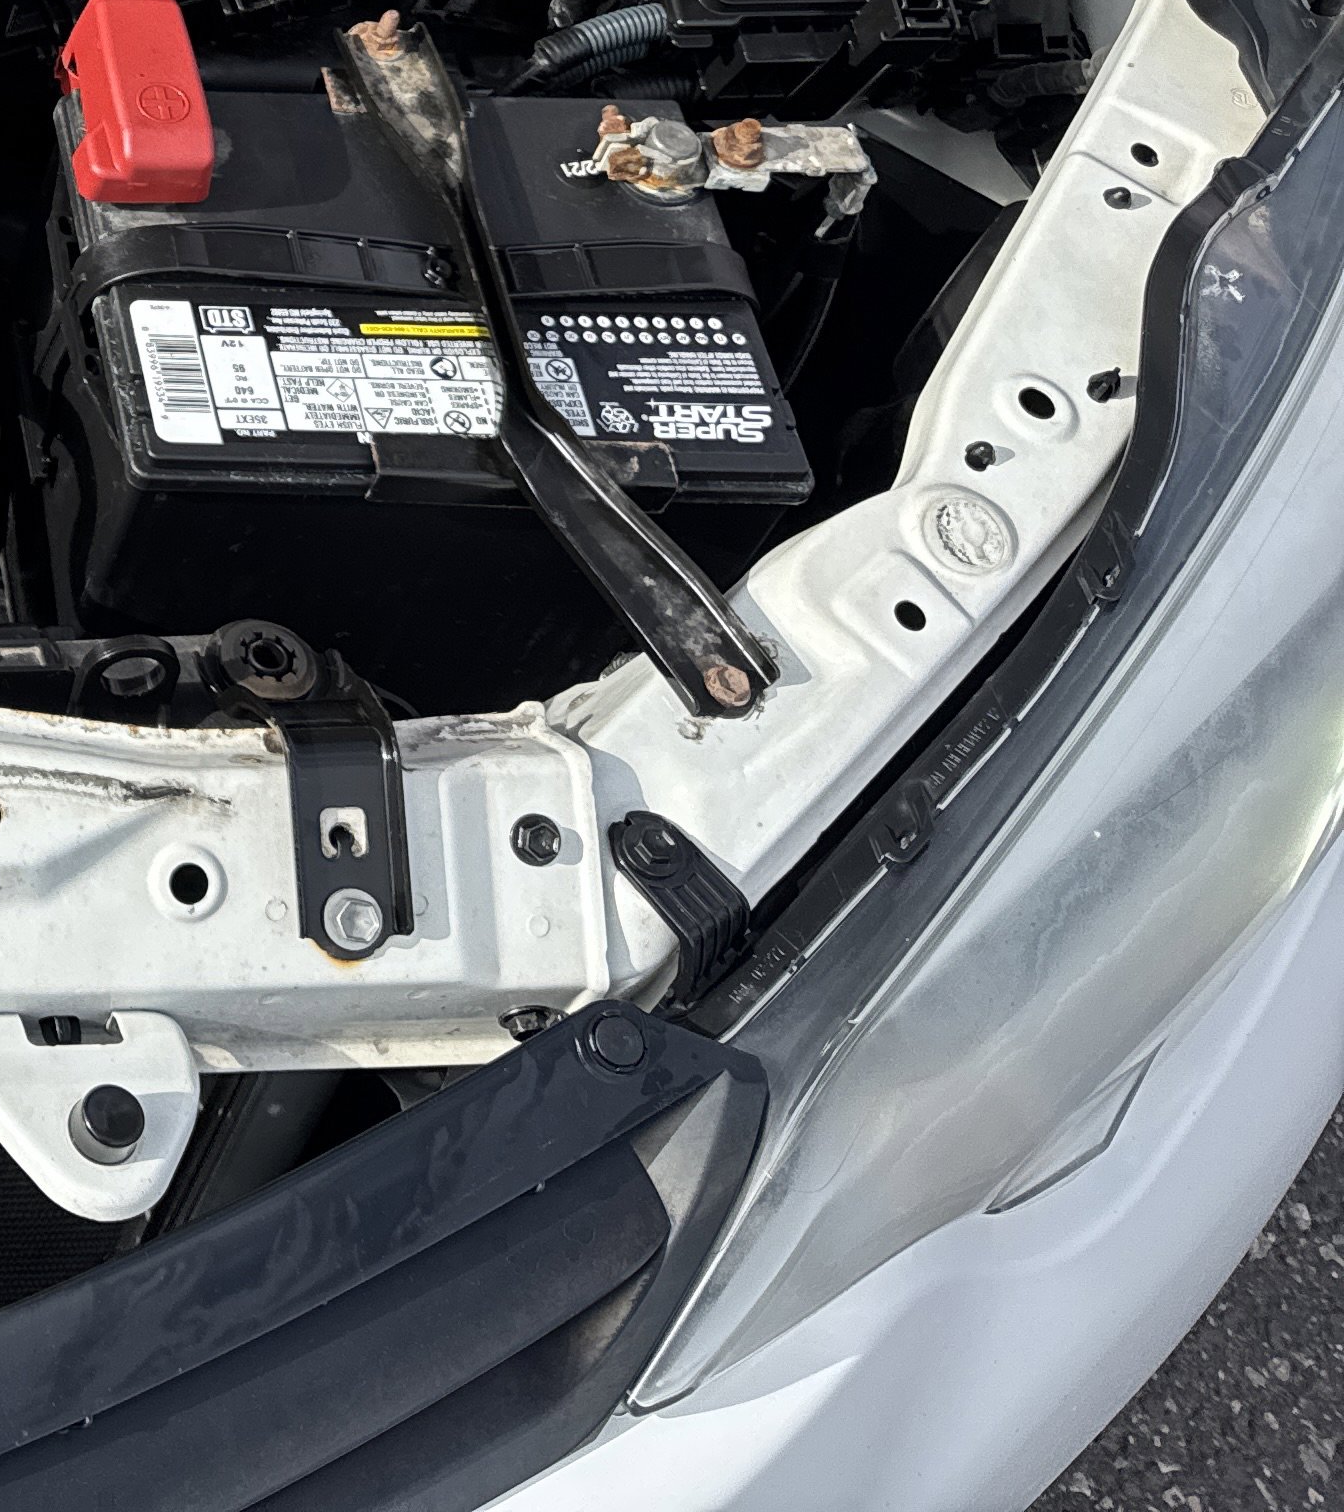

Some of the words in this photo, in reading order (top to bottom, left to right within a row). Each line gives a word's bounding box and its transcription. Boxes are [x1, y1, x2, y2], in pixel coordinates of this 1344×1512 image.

[206, 308, 247, 328] STD
[221, 339, 244, 348] 12V
[232, 364, 245, 373] 95
[234, 385, 254, 395] 640
[235, 413, 268, 425] 35EXT
[304, 411, 360, 423] IMMEDIATELY
[649, 405, 772, 429] START
[653, 421, 765, 443] SUPER
